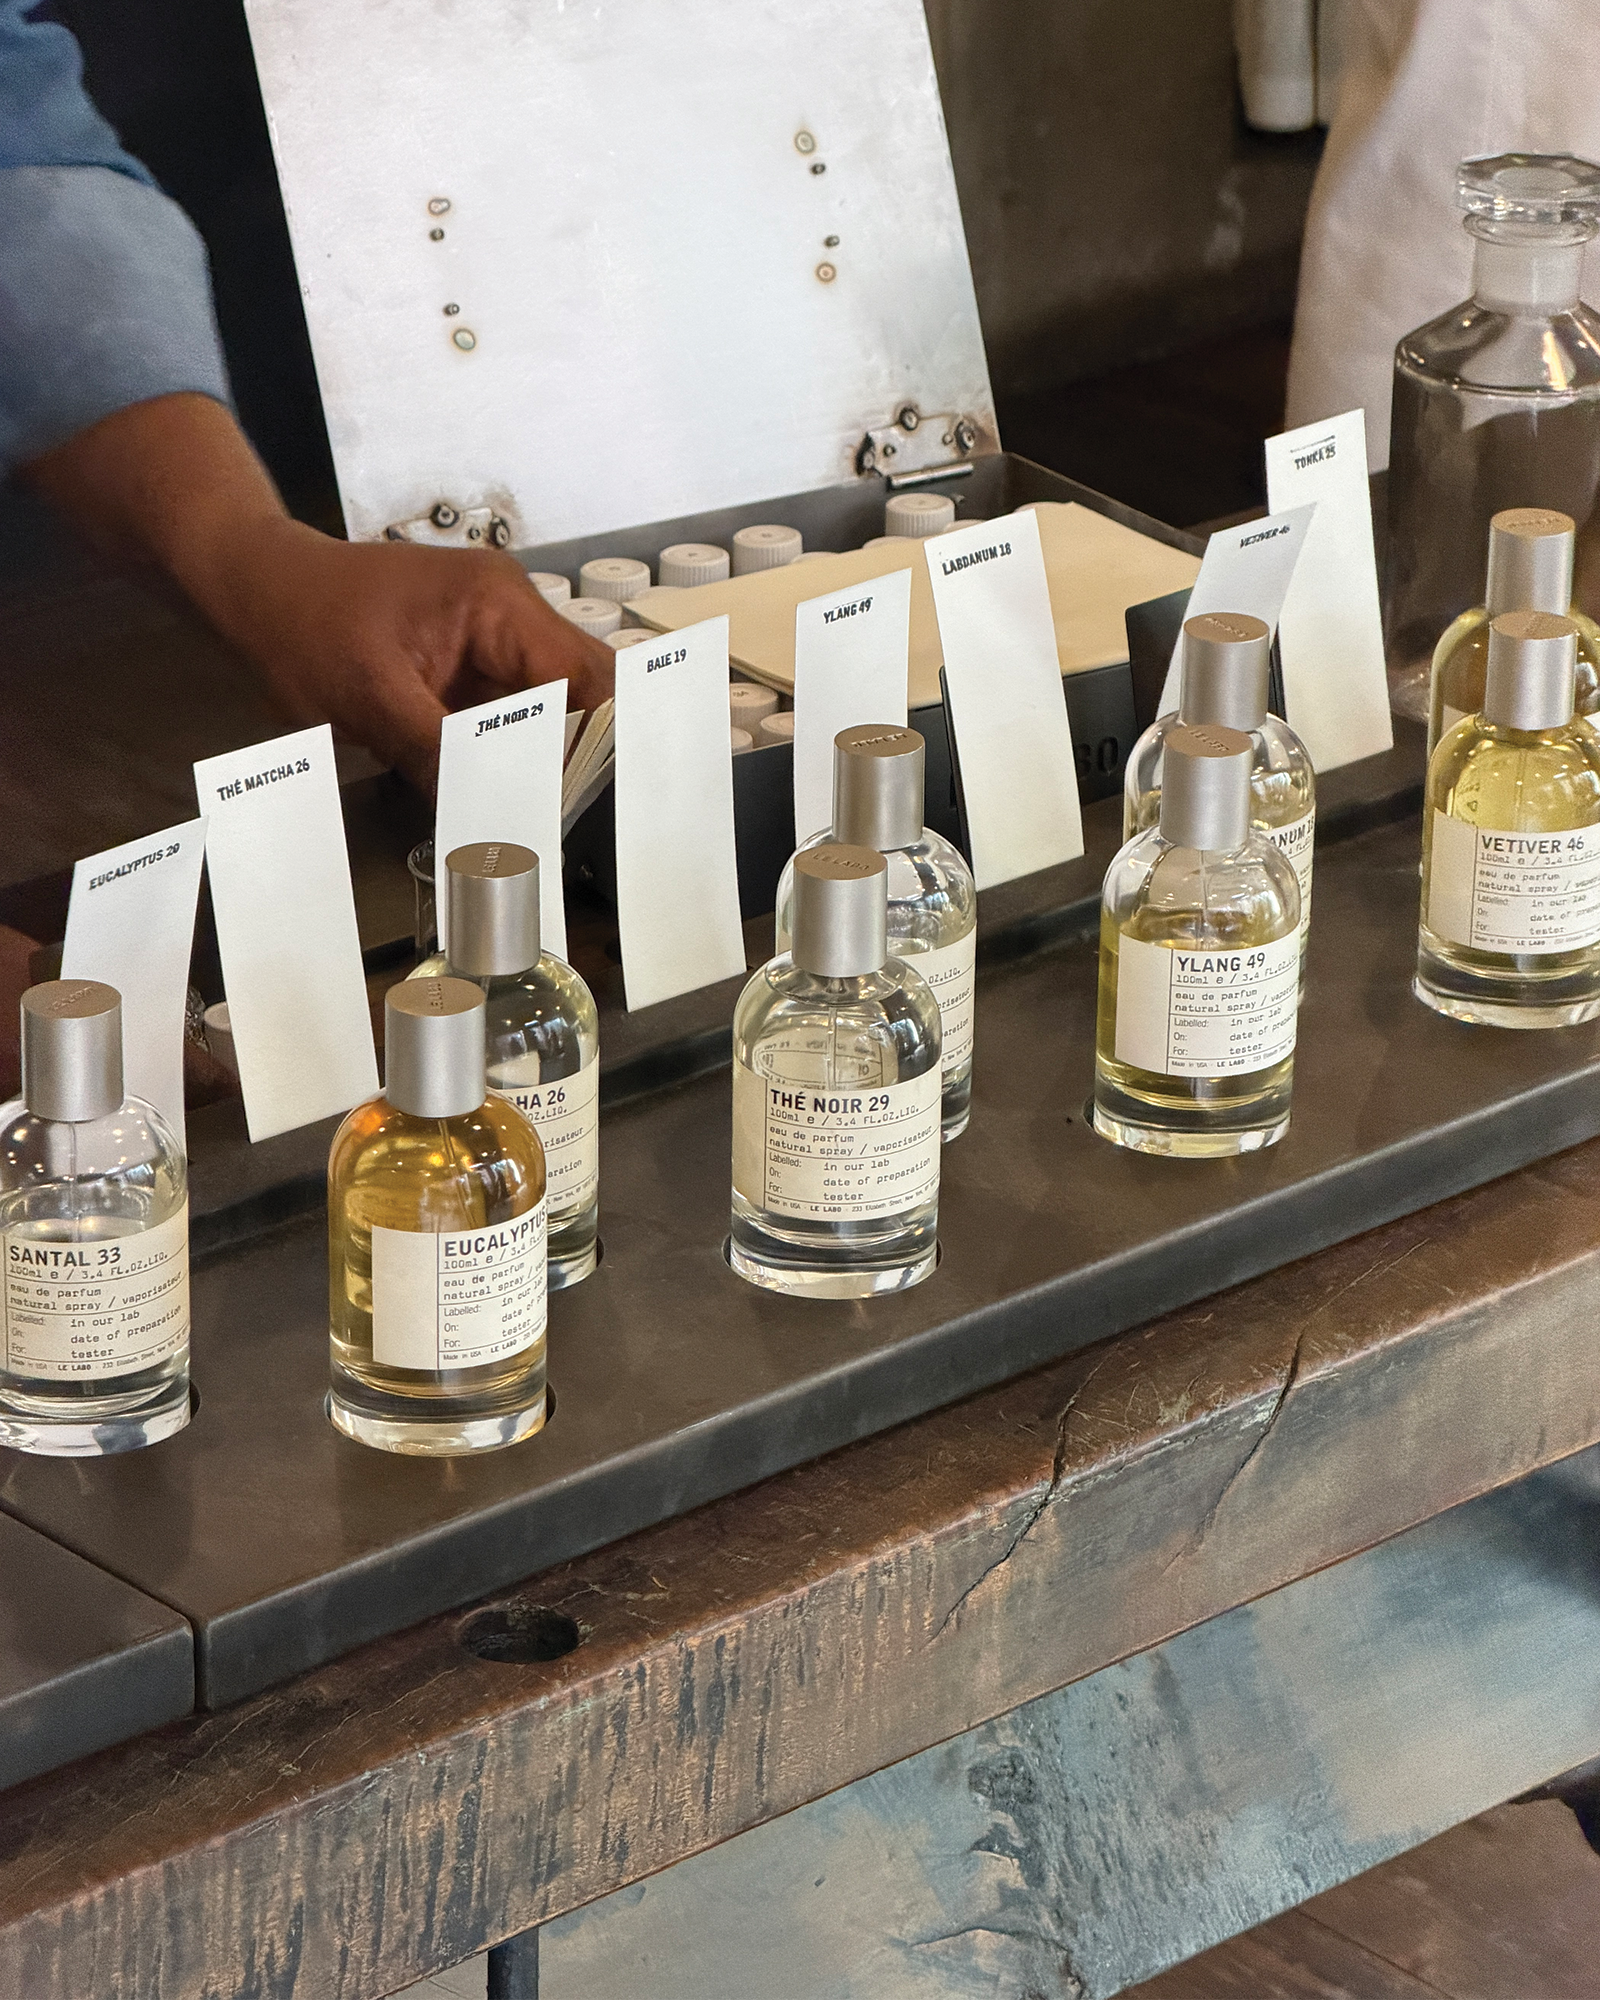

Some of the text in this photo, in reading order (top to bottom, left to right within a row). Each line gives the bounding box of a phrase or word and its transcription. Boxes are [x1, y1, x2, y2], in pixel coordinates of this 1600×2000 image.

[942, 542, 1012, 576] LABDANUM 18
[823, 598, 872, 624] YLANG 49
[647, 648, 687, 673] BAIE 19
[478, 702, 544, 734] THÉ NOIR 29
[216, 757, 311, 801] THÉ MATCHA 26
[1269, 824, 1306, 848] ANUM
[1481, 834, 1585, 854] VETIVER 46
[88, 842, 181, 891] EUCALYPTUS 20
[1480, 852, 1510, 864] 100ml
[1479, 869, 1560, 882] eau de parfum
[1478, 881, 1558, 893] natural spray
[1531, 900, 1544, 908] in
[1549, 898, 1567, 906] our
[1530, 912, 1555, 922] date
[1560, 910, 1571, 919] of
[1529, 926, 1565, 936] tester
[1177, 956, 1241, 973] YLANG
[1246, 952, 1266, 969] 49
[1176, 971, 1260, 984] 100ml 3.4
[938, 988, 970, 1009] risateur
[1175, 989, 1258, 1001] eau de parfum
[1174, 1006, 1282, 1028] Labelled: in our lab
[1175, 1001, 1256, 1013] natural spray
[943, 1017, 969, 1038] aration
[1173, 1025, 1268, 1041] On: date of
[1173, 1046, 1188, 1056] For:
[1229, 1042, 1263, 1055] tester
[1228, 1059, 1245, 1067] LABO
[547, 1086, 565, 1105] 26
[770, 1089, 890, 1114] THÉ NOIR 29
[770, 1108, 799, 1122] 100ml
[836, 1117, 856, 1126] 3.4
[863, 1105, 919, 1124] FL.OZ.LIQ.
[544, 1127, 584, 1148] risateur
[769, 1125, 855, 1143] eau de parfum
[769, 1137, 812, 1154] natural
[819, 1147, 853, 1156] spray
[873, 1126, 933, 1153] vaporisateur
[548, 1159, 582, 1178] aration
[769, 1153, 890, 1171] Labelled: in our lab
[769, 1167, 781, 1178] On:
[823, 1177, 851, 1187] date
[857, 1176, 870, 1186] of
[877, 1158, 931, 1185] preparation
[768, 1182, 864, 1201] For: tester
[444, 1205, 547, 1257] EUCALYPTUS
[10, 1245, 122, 1267] SANTAL 33
[444, 1258, 478, 1270] 100ml
[511, 1244, 526, 1256] 3.4
[9, 1264, 42, 1278] 100ml
[82, 1270, 103, 1279] 3.4
[444, 1279, 465, 1287] eau
[472, 1275, 485, 1284] de
[492, 1262, 525, 1282] parfum
[9, 1296, 57, 1310] natural
[65, 1301, 101, 1311] spray
[122, 1270, 183, 1305] vaporisateur
[10, 1282, 102, 1298] eau de parfum
[444, 1276, 524, 1300] natural spray
[444, 1305, 482, 1317] Labelled:
[501, 1297, 513, 1307] in
[517, 1289, 531, 1301] our
[70, 1318, 85, 1328] in
[92, 1318, 114, 1327] our
[120, 1309, 140, 1323] lab
[70, 1333, 100, 1344] date
[106, 1329, 121, 1341] of
[127, 1304, 182, 1338] preparation
[444, 1299, 535, 1332] On: date of
[444, 1339, 461, 1348] For:
[502, 1318, 531, 1338] tester
[71, 1348, 115, 1359] tester
[490, 1346, 498, 1354] LE
[502, 1340, 517, 1350] LABO
